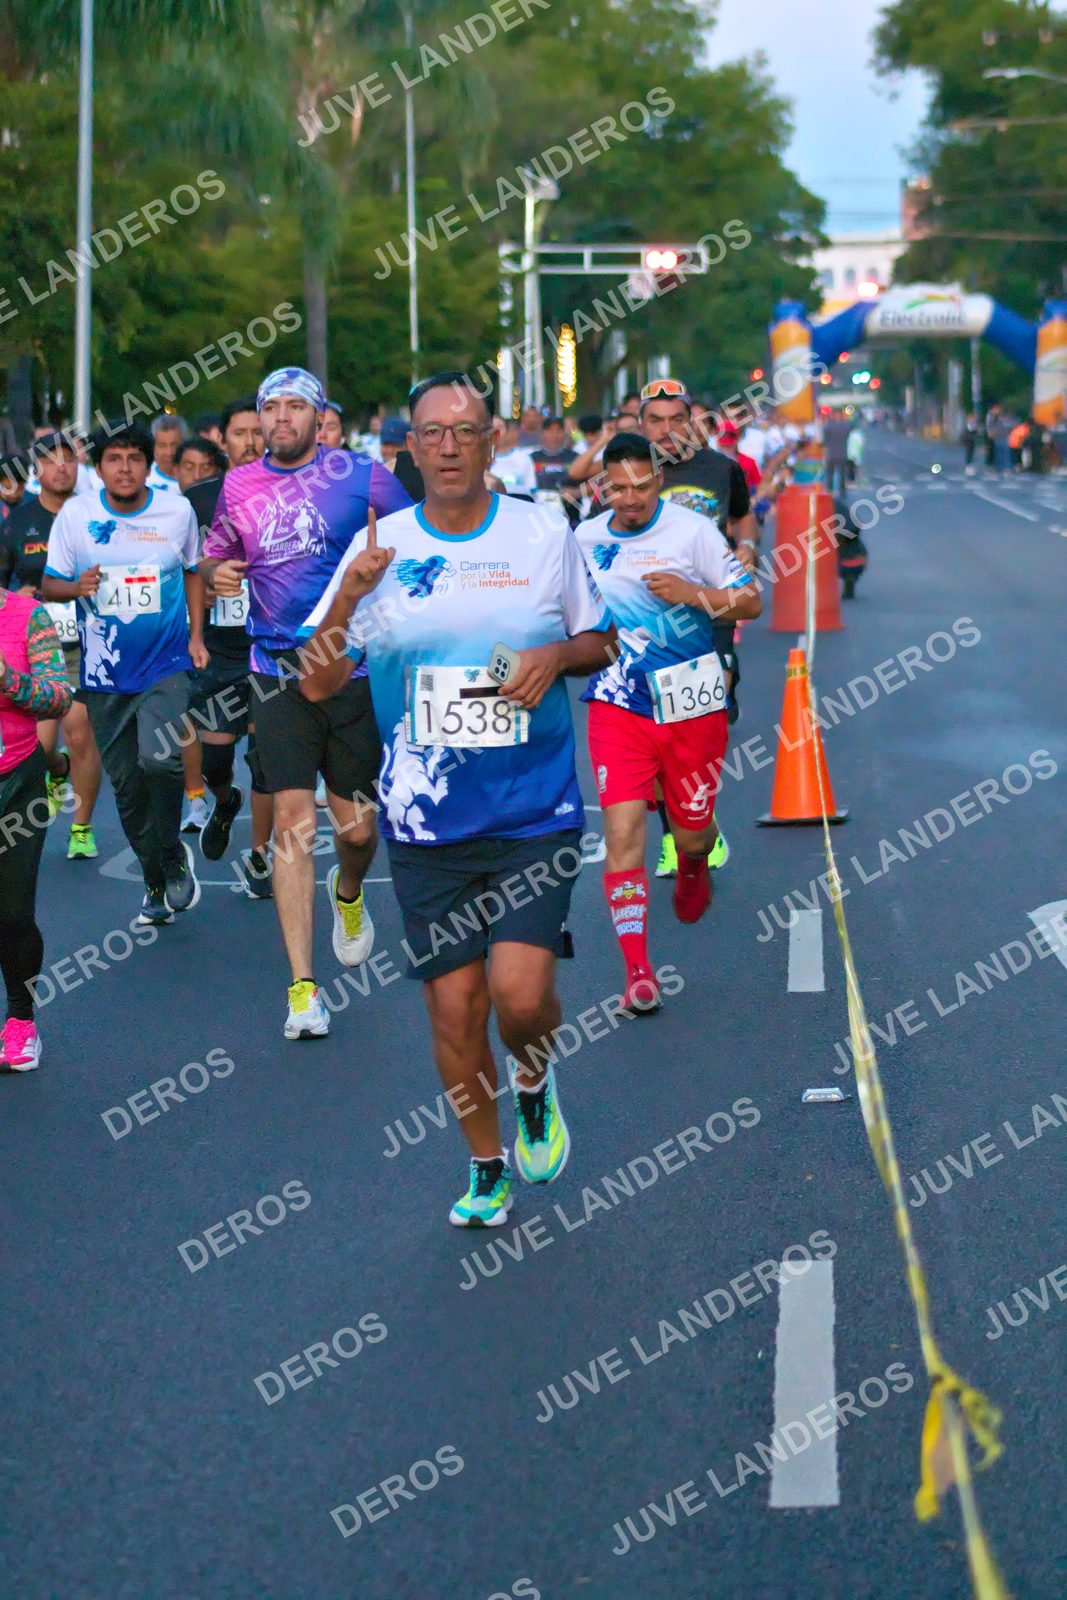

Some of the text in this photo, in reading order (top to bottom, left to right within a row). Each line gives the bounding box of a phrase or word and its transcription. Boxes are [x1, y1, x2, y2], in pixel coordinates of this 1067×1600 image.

[460, 561, 509, 571] Carrera
[461, 570, 511, 582] por la Vida
[461, 579, 529, 590] y la Integridad
[108, 585, 152, 607] 415
[220, 600, 244, 620] 13
[666, 676, 725, 714] 1366
[422, 699, 512, 735] 1538
